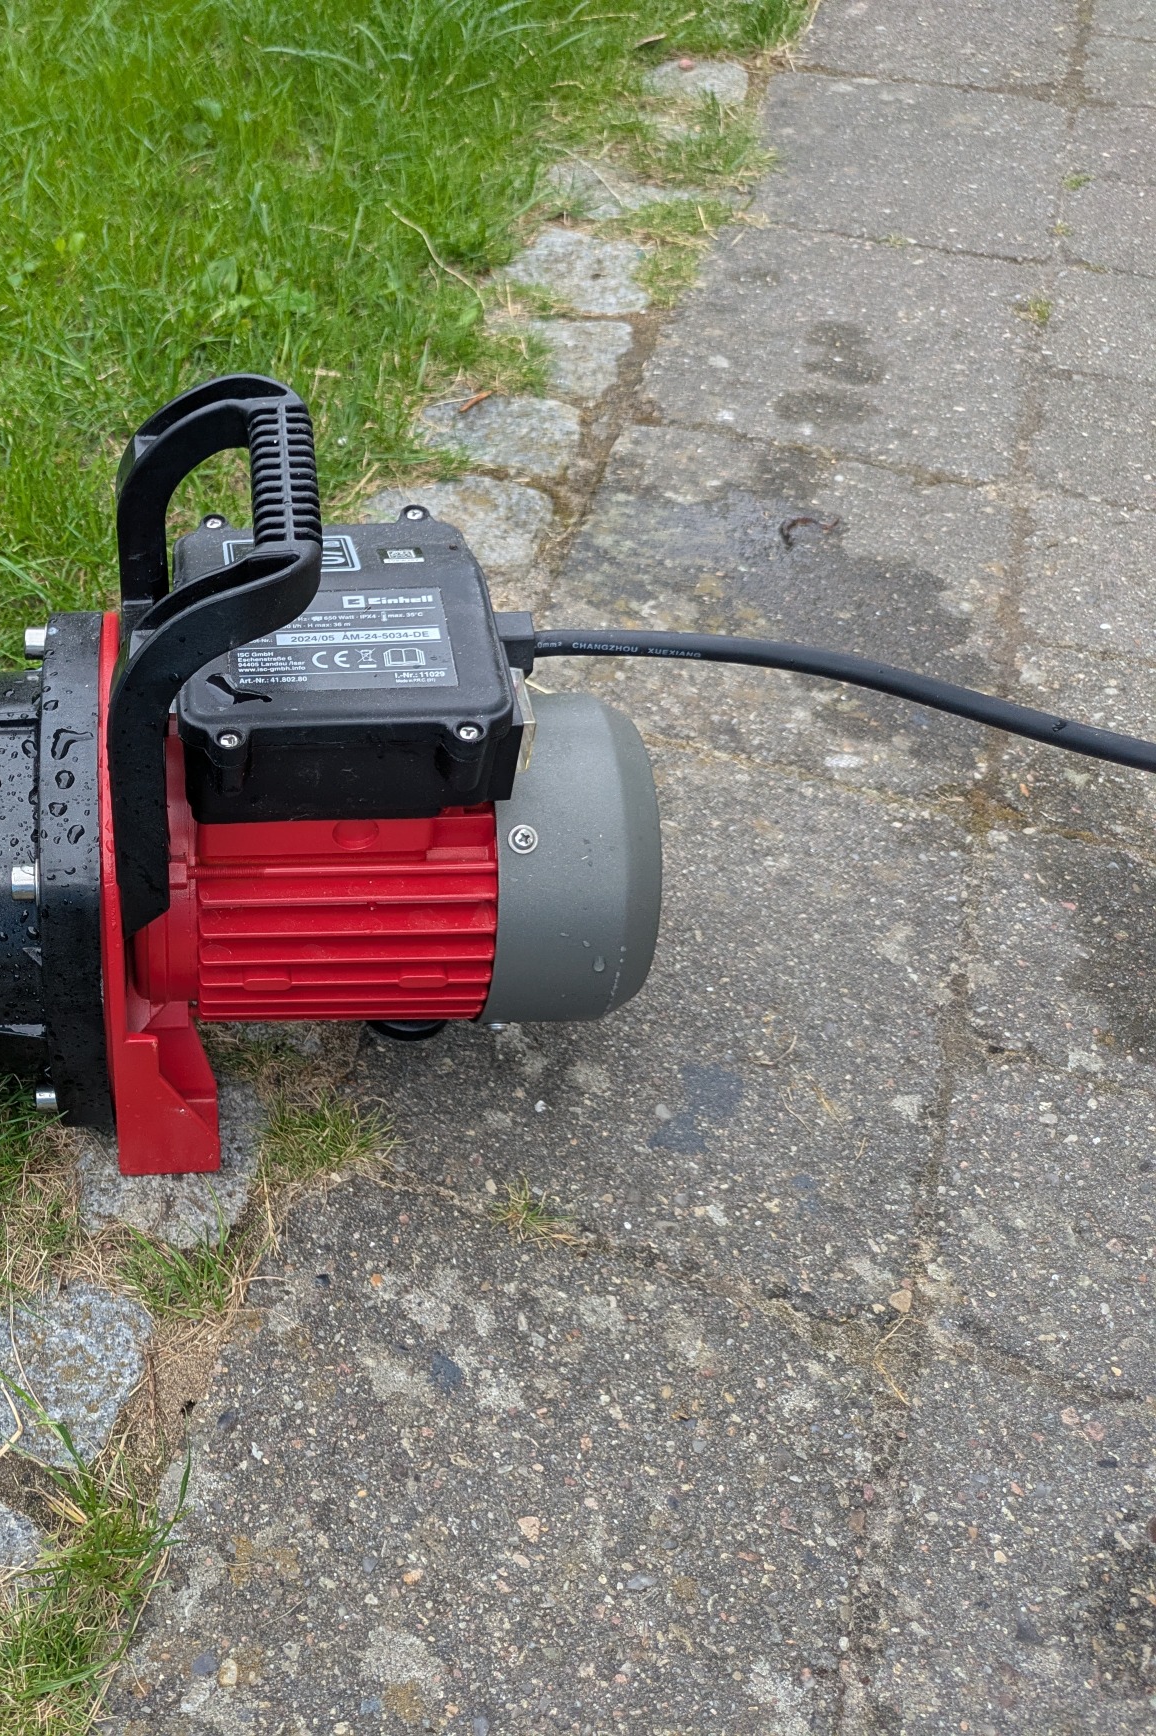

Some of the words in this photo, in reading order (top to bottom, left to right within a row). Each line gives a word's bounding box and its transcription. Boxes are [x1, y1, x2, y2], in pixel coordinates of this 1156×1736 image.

[367, 595, 434, 605] Einhell
[290, 634, 335, 643] 2024/05
[341, 631, 430, 641] AM-24-5034-DE
[572, 641, 639, 653] CHANGZHOU
[647, 647, 702, 658] XUEXIANG
